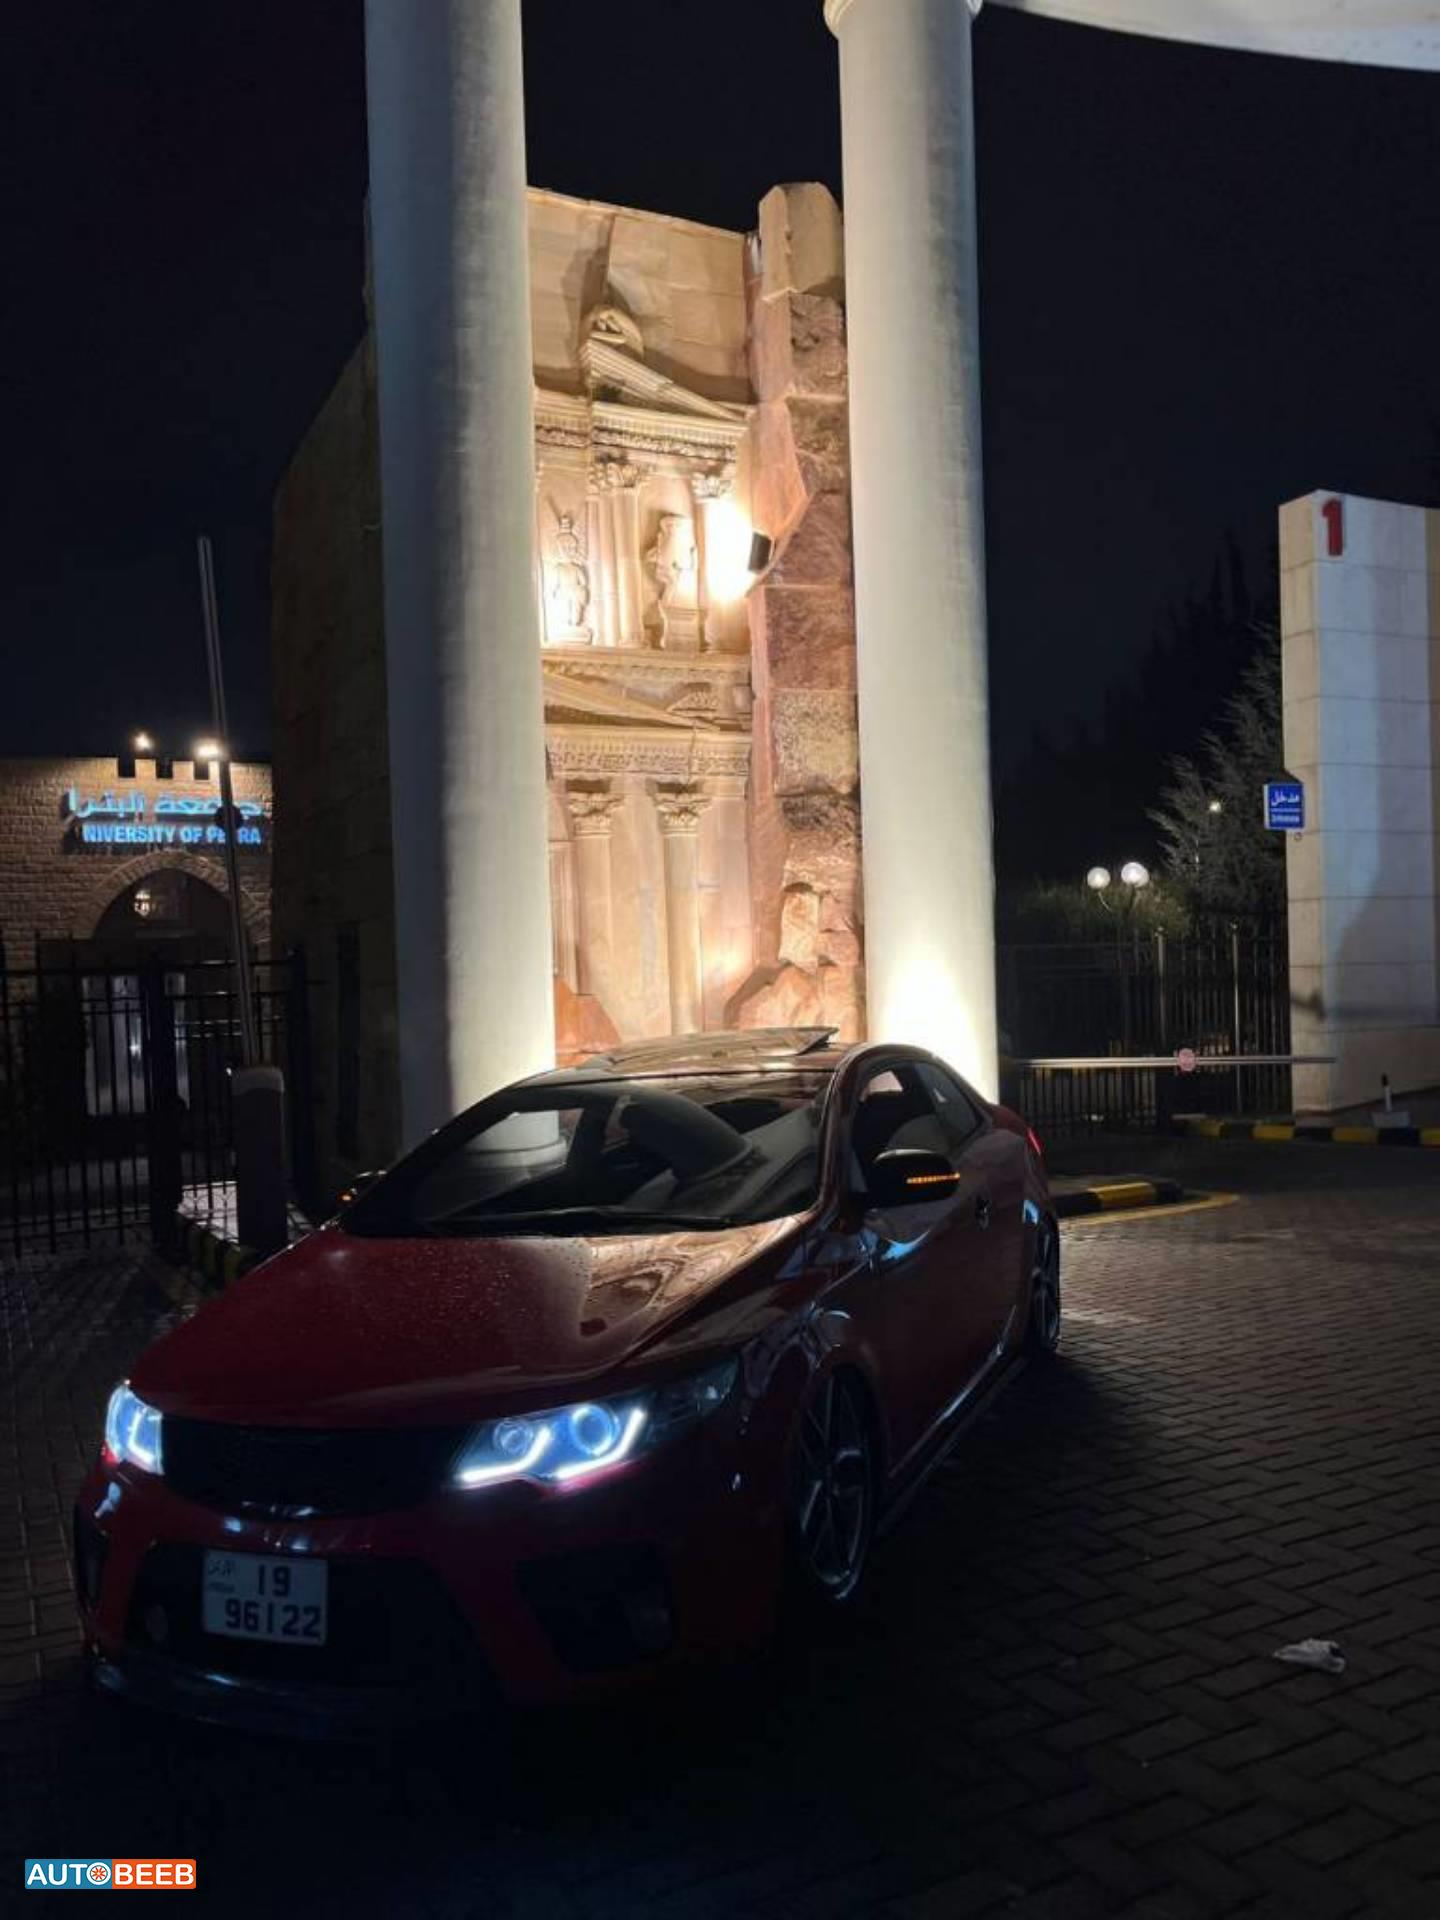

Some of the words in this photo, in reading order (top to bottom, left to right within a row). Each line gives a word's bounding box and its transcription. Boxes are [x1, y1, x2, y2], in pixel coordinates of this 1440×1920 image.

[1321, 497, 1343, 557] 1
[154, 793, 262, 820] جمعة
[70, 824, 176, 844] NIVERSITY
[181, 826, 203, 843] OF
[206, 826, 262, 845] PERA
[257, 1564, 291, 1597] 19
[225, 1598, 321, 1637] 96122
